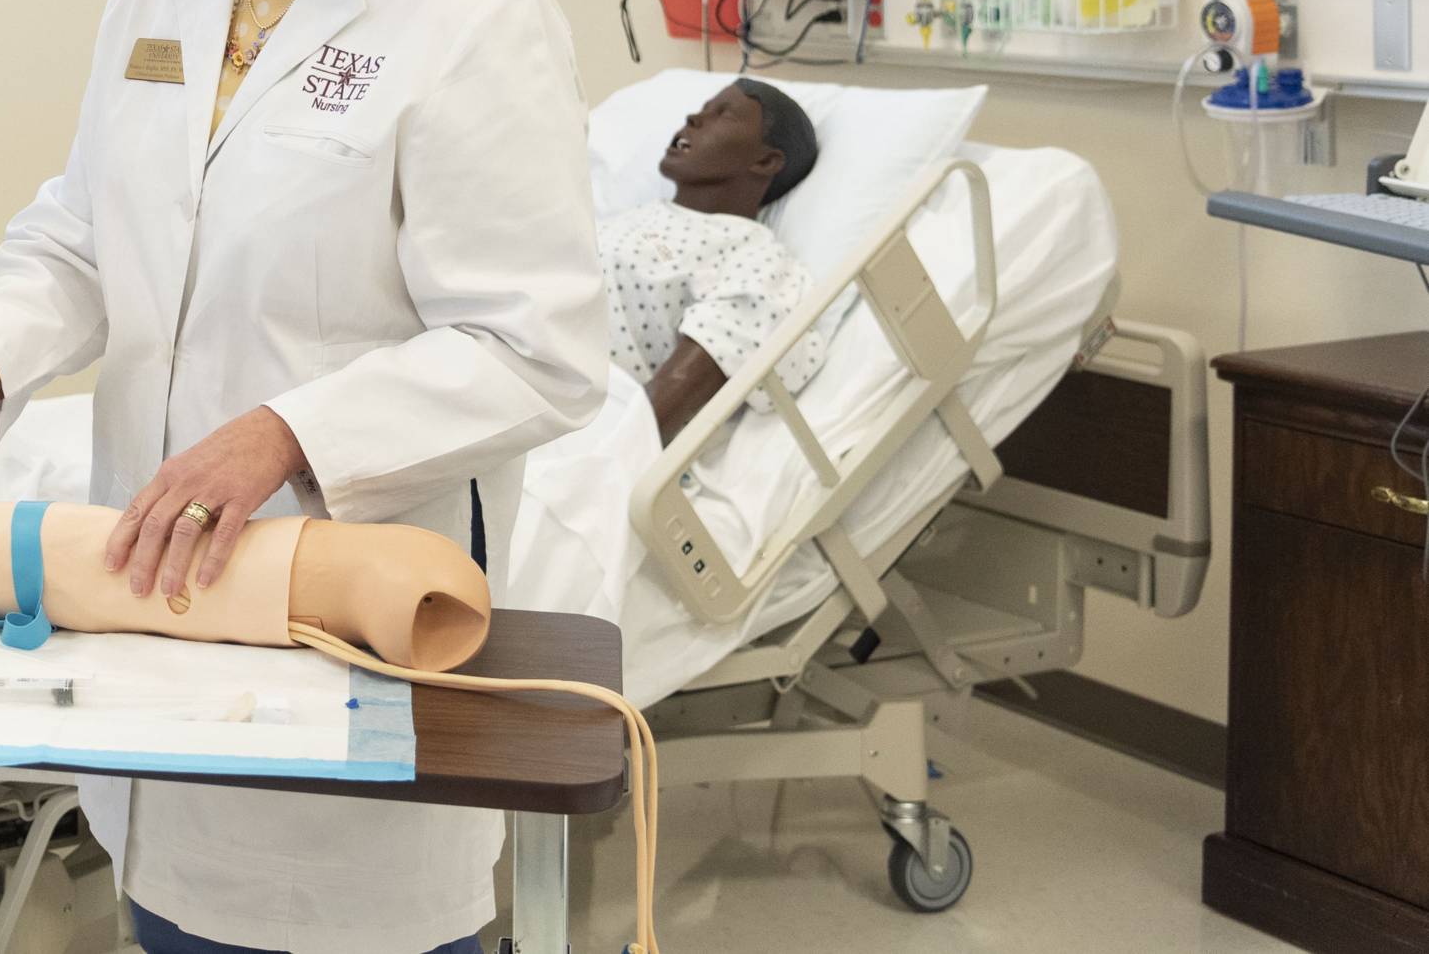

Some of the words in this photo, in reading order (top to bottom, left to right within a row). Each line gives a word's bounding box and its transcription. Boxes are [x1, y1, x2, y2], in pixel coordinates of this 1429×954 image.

[316, 44, 386, 74] TEXAS
[302, 74, 370, 100] STATE
[311, 97, 349, 115] Nursing
